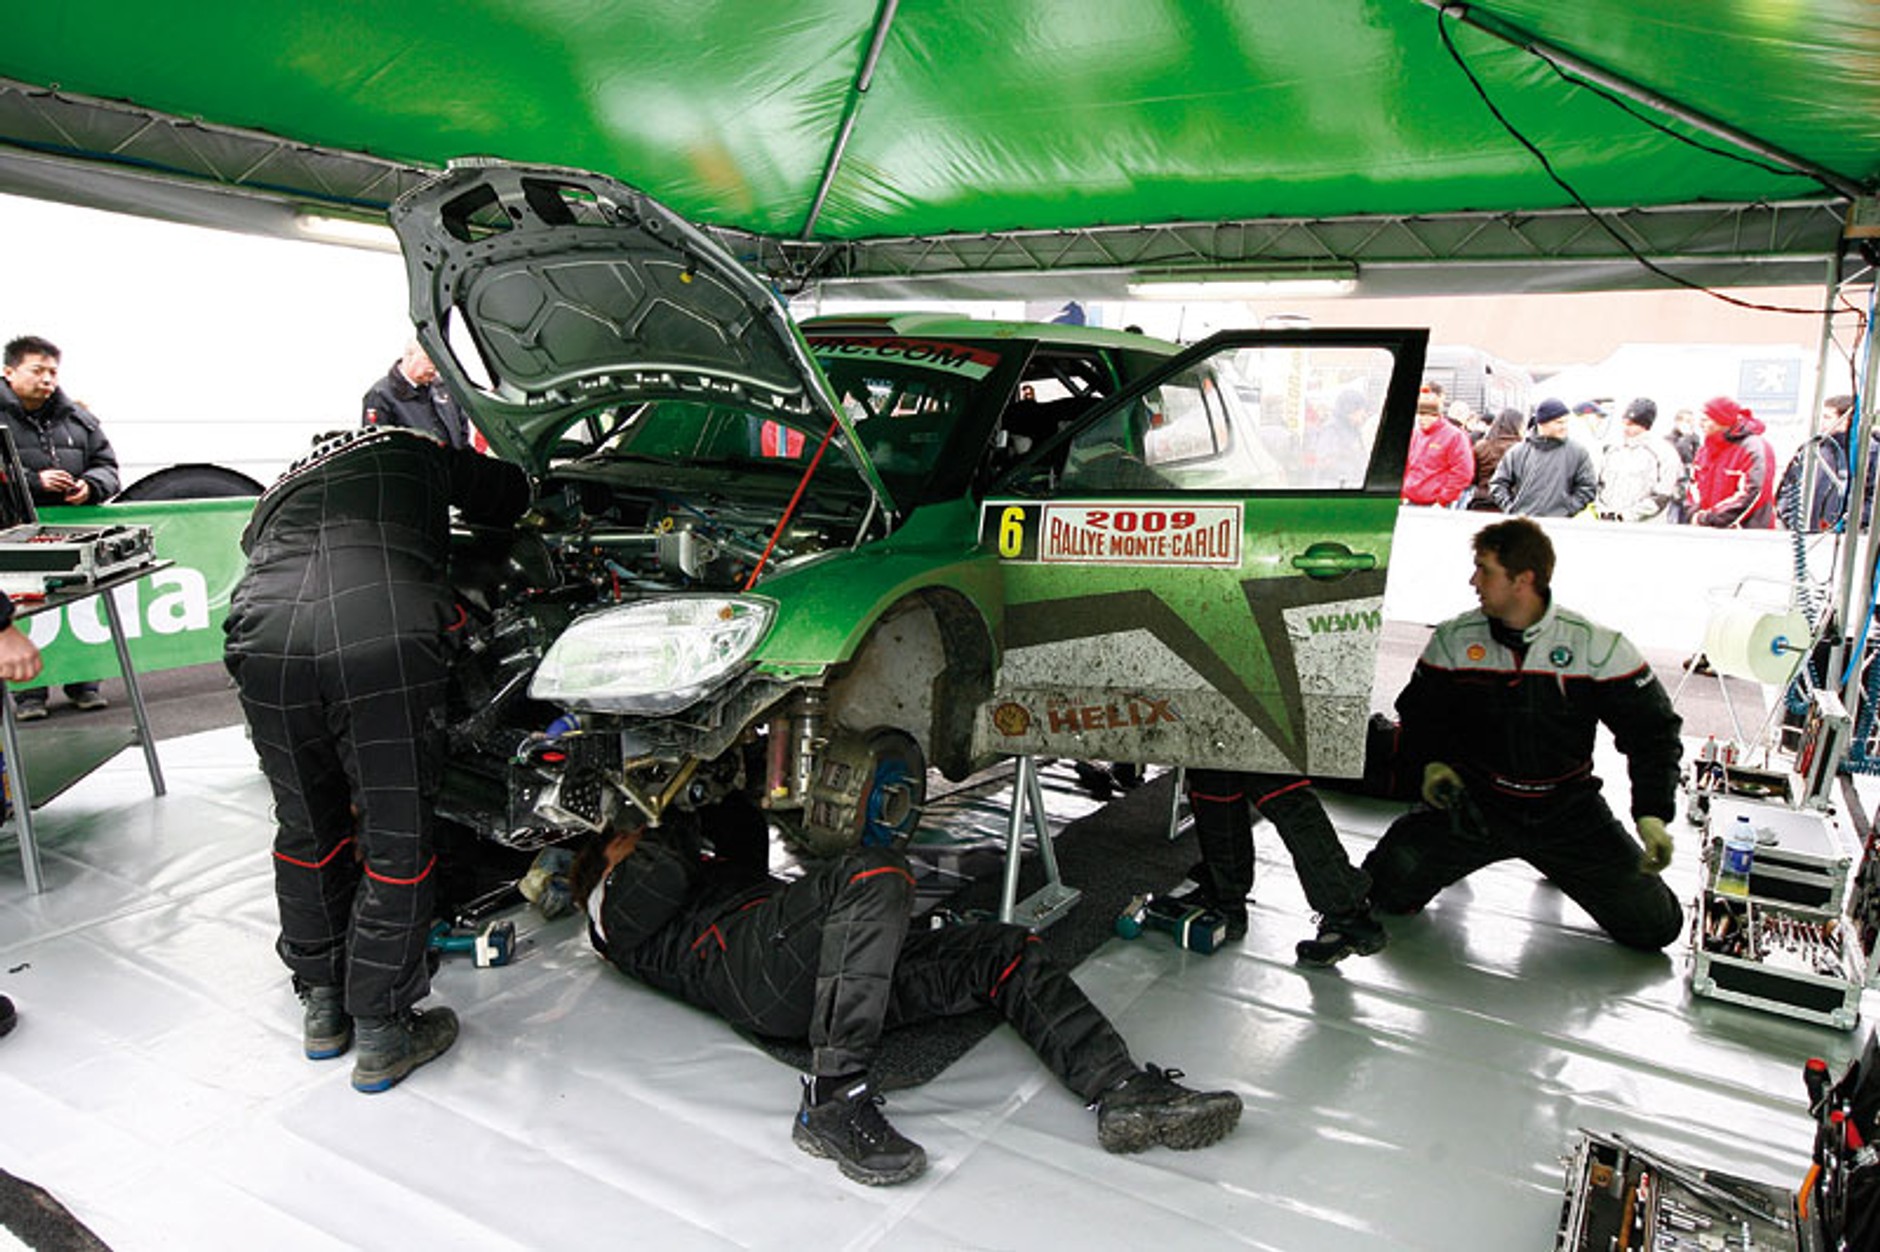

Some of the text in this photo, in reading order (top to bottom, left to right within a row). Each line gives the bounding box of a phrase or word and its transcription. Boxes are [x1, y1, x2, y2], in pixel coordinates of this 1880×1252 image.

[1000, 506, 1026, 558] 6
[1050, 516, 1231, 558] RALLYE MONTE-CARLO
[1085, 510, 1196, 533] 2009
[1048, 697, 1178, 734] HELIX
